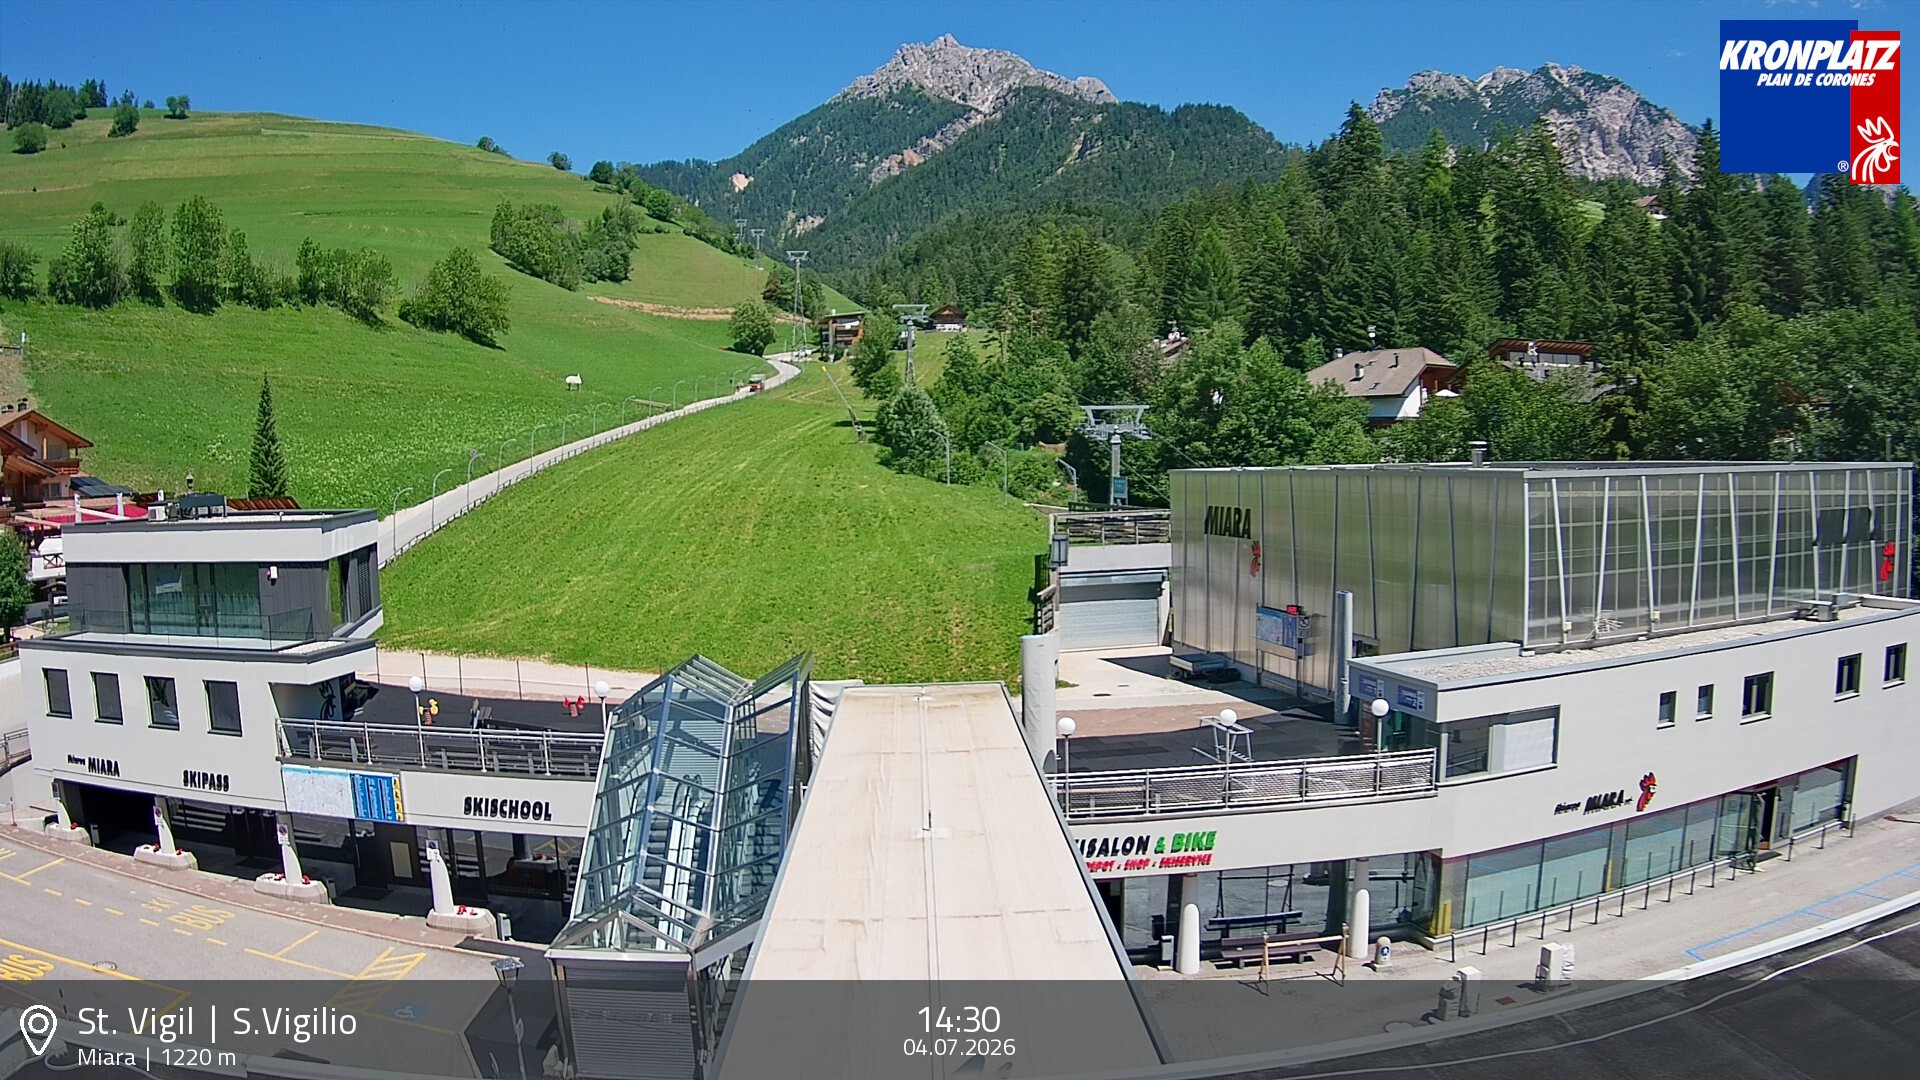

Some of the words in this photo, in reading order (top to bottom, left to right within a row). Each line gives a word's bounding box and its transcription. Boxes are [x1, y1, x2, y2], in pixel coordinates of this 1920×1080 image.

[1204, 505, 1252, 539] MIARA
[88, 757, 120, 777] MIARA
[183, 770, 229, 792] SKIPASS
[463, 796, 552, 821] SKISCHOOL
[1583, 790, 1624, 815] MIARA
[1075, 835, 1151, 858] ISALON
[1154, 836, 1167, 854] &
[1170, 831, 1217, 853] BIKE
[1123, 858, 1151, 871] SHOP
[141, 897, 180, 913] SKI
[167, 904, 235, 931] BUS
